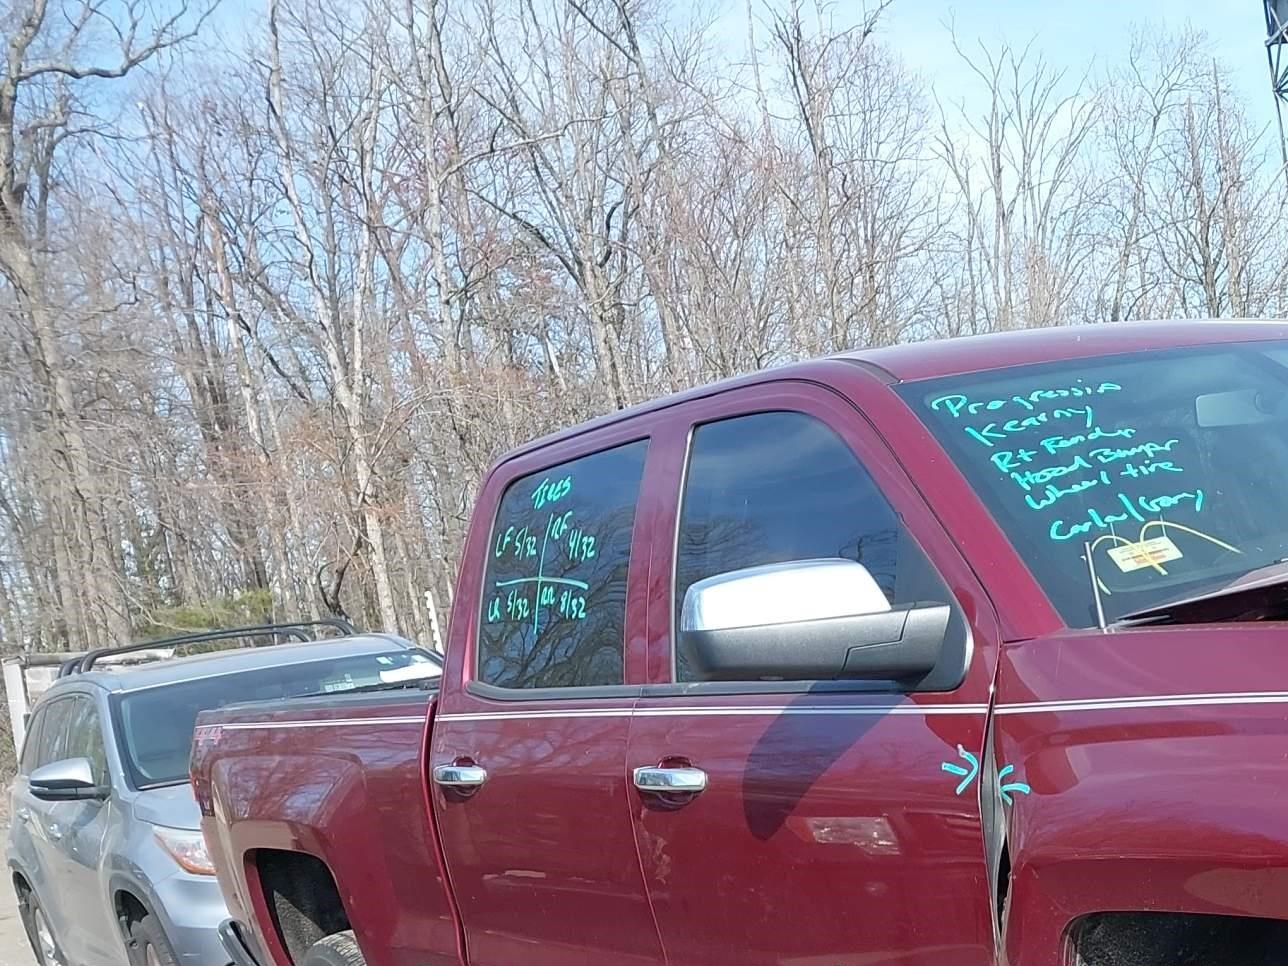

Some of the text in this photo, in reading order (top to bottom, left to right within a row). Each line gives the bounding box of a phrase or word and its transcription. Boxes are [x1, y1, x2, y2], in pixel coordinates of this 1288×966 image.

[1010, 455, 1092, 491] Hood
[1025, 470, 1111, 510] Wheel
[495, 525, 515, 558] LF
